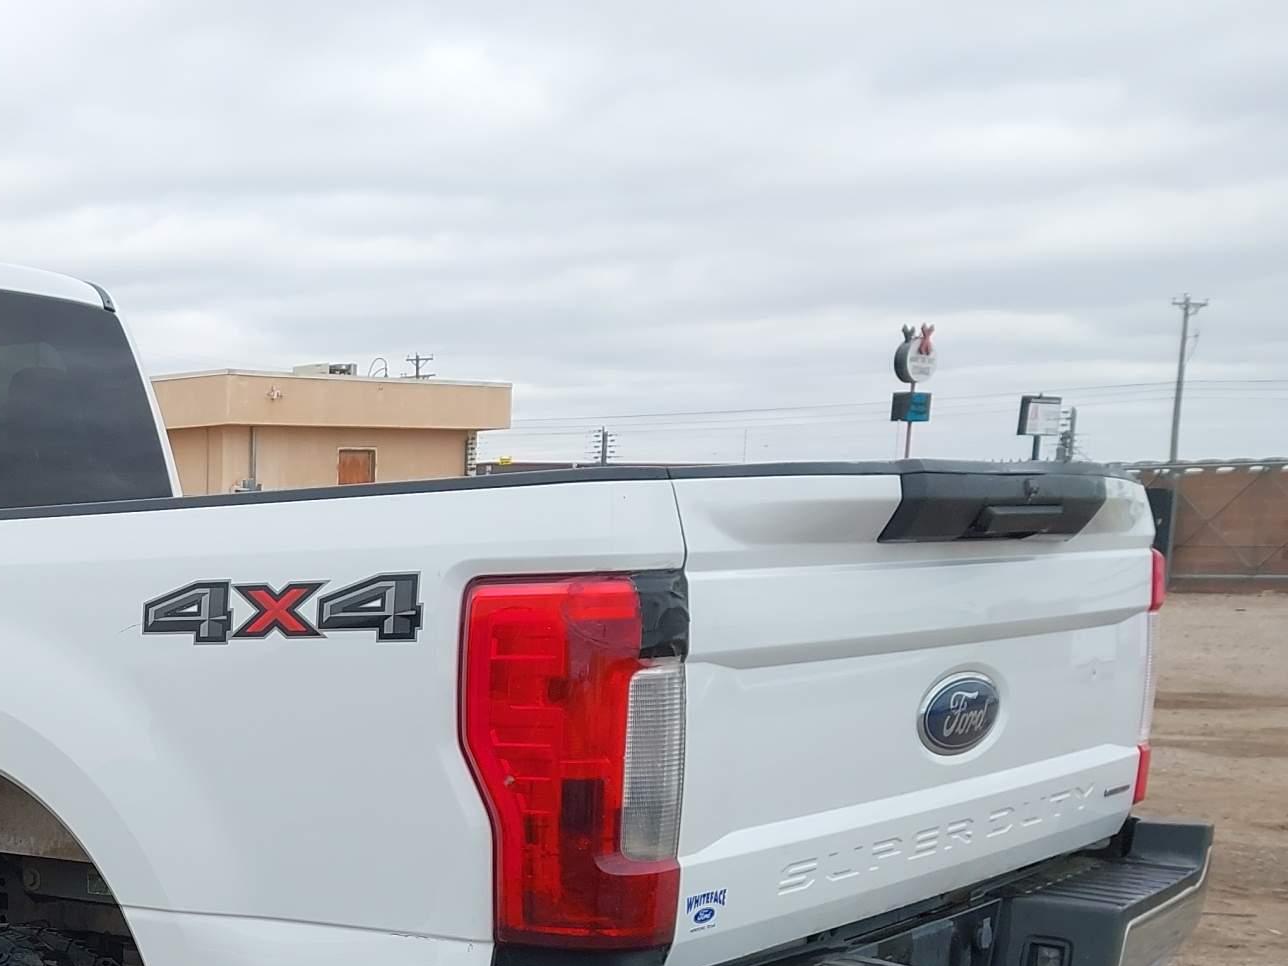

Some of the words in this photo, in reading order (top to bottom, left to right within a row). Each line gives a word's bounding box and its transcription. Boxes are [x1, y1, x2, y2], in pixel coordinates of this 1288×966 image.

[943, 690, 995, 737] Ford
[776, 817, 975, 896] SUPER
[984, 783, 1095, 838] DUTY
[686, 888, 727, 915] WHITEFACE
